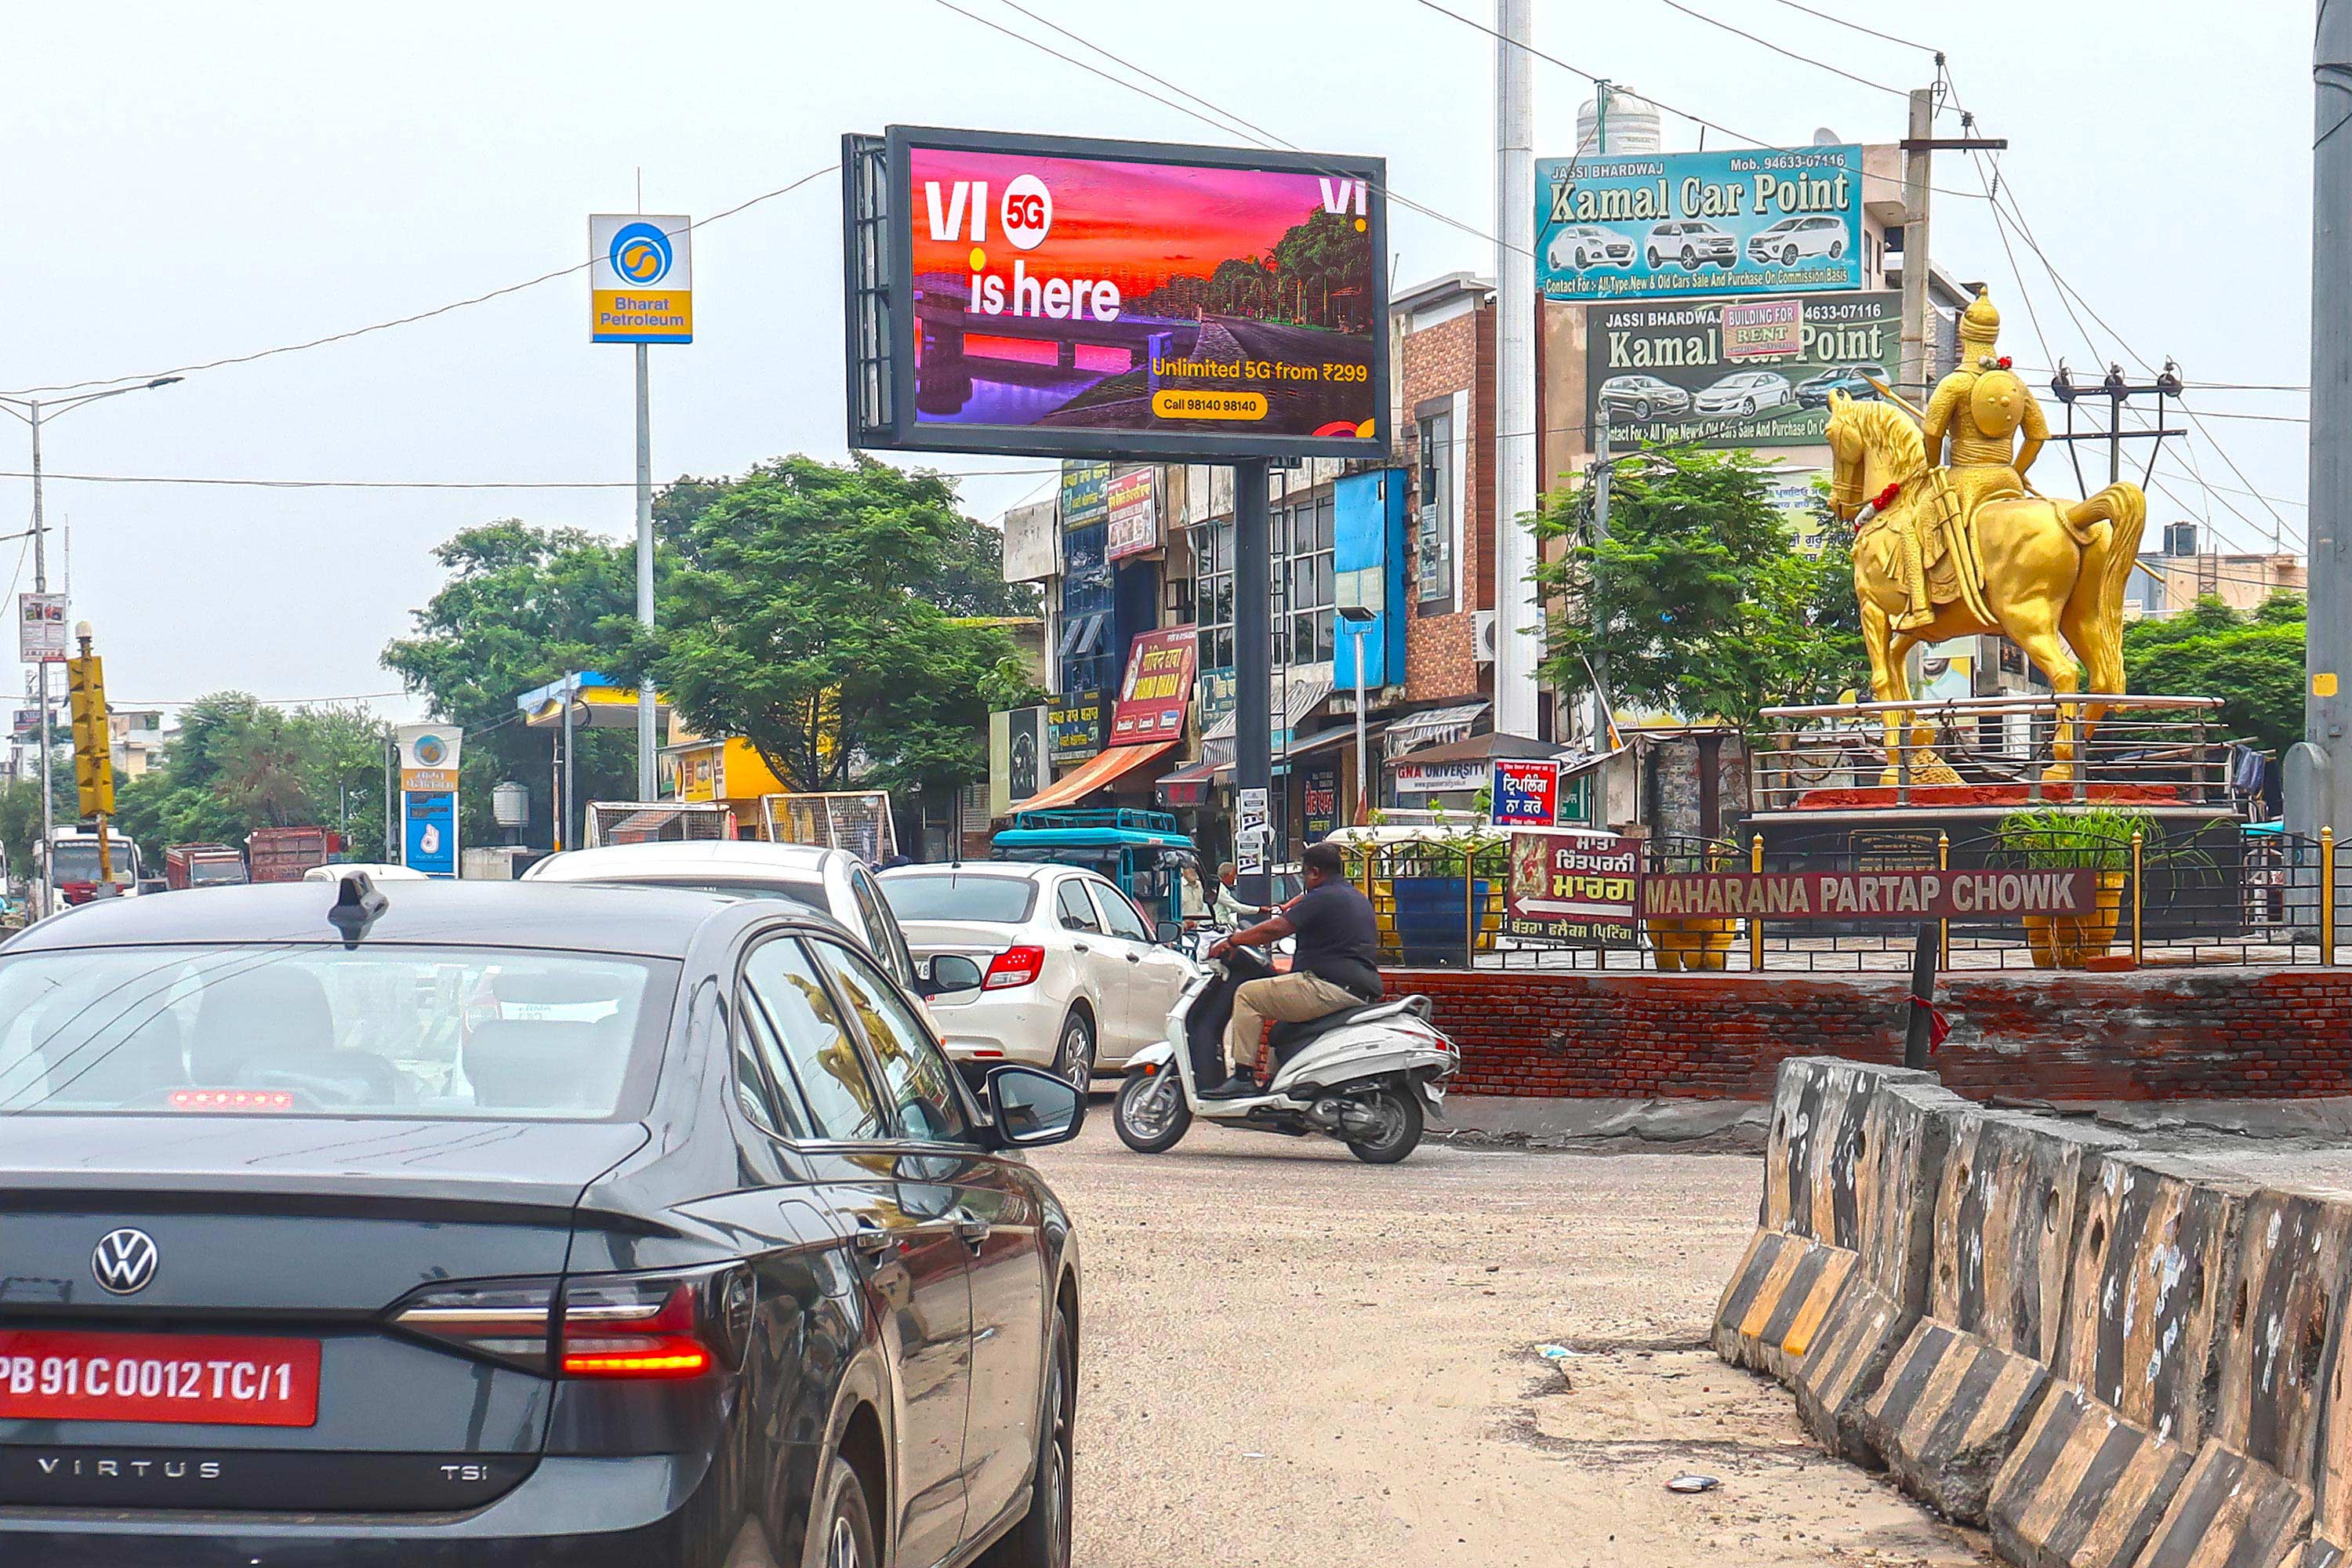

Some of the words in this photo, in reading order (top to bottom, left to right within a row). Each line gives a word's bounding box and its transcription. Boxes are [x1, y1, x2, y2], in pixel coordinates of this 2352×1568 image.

[1552, 165, 1588, 179] JASSI
[1592, 162, 1664, 178] BHARDWAJ
[1730, 158, 1761, 171] Mob.
[1764, 154, 1846, 169] 94633-07116
[1550, 179, 1671, 223] Kamal
[1680, 176, 1744, 219] Car
[1753, 172, 1849, 215] Point
[1007, 194, 1044, 230] 5G
[971, 248, 1006, 315] is
[1014, 260, 1121, 321] here
[1545, 278, 1575, 294] Contact
[1577, 274, 1590, 292] For
[1649, 274, 1657, 289] &
[1657, 273, 1671, 289] Old
[1672, 274, 1690, 289] Cars
[1692, 272, 1708, 288] Sale
[1710, 273, 1726, 287] And
[1727, 272, 1763, 286] Purchase
[1765, 269, 1777, 285] On
[1777, 267, 1825, 285] Commission
[1825, 267, 1849, 283] Basis
[615, 297, 670, 310] Bharat
[1803, 303, 1882, 320] 4633-07116
[601, 313, 684, 326] Petroleum
[1605, 313, 1644, 328] JASSI
[1648, 310, 1722, 326] BHARDWAJ
[1728, 308, 1773, 326] BUILDING
[1775, 307, 1795, 323] FOR
[1736, 326, 1788, 343] RENT
[1608, 328, 1718, 368] Kamal
[1795, 323, 1883, 361] Point
[1152, 358, 1240, 378] Unlimited
[1245, 360, 1271, 379] 5G
[1275, 361, 1318, 380] from
[1323, 363, 1367, 382] ₹299
[1163, 398, 1185, 410] Call
[1187, 399, 1221, 411] 98140
[1223, 400, 1257, 412] 98140
[1609, 425, 1629, 441] ntact
[1630, 424, 1642, 441] For
[1650, 423, 1660, 440] All
[1661, 423, 1679, 444] Type
[1680, 423, 1697, 441] New
[1706, 422, 1719, 439] Old
[1757, 421, 1770, 437] And
[1772, 419, 1806, 437] Purchase
[1807, 419, 1818, 435] On
[1398, 766, 1421, 779] GNA
[1425, 762, 1486, 779] UNIVERSITY
[1506, 800, 1520, 813] ਨਾ
[1552, 875, 1636, 902] ਮਾਰਗ
[1646, 875, 1810, 913] MAHARANA
[1820, 875, 1941, 913] PARTAP
[1952, 873, 2077, 911] CHOWK
[40, 1357, 78, 1395] 91
[85, 1358, 111, 1396] C
[114, 1359, 203, 1399] 0012
[207, 1360, 292, 1401] TC/1
[38, 1457, 221, 1479] VIRTUS
